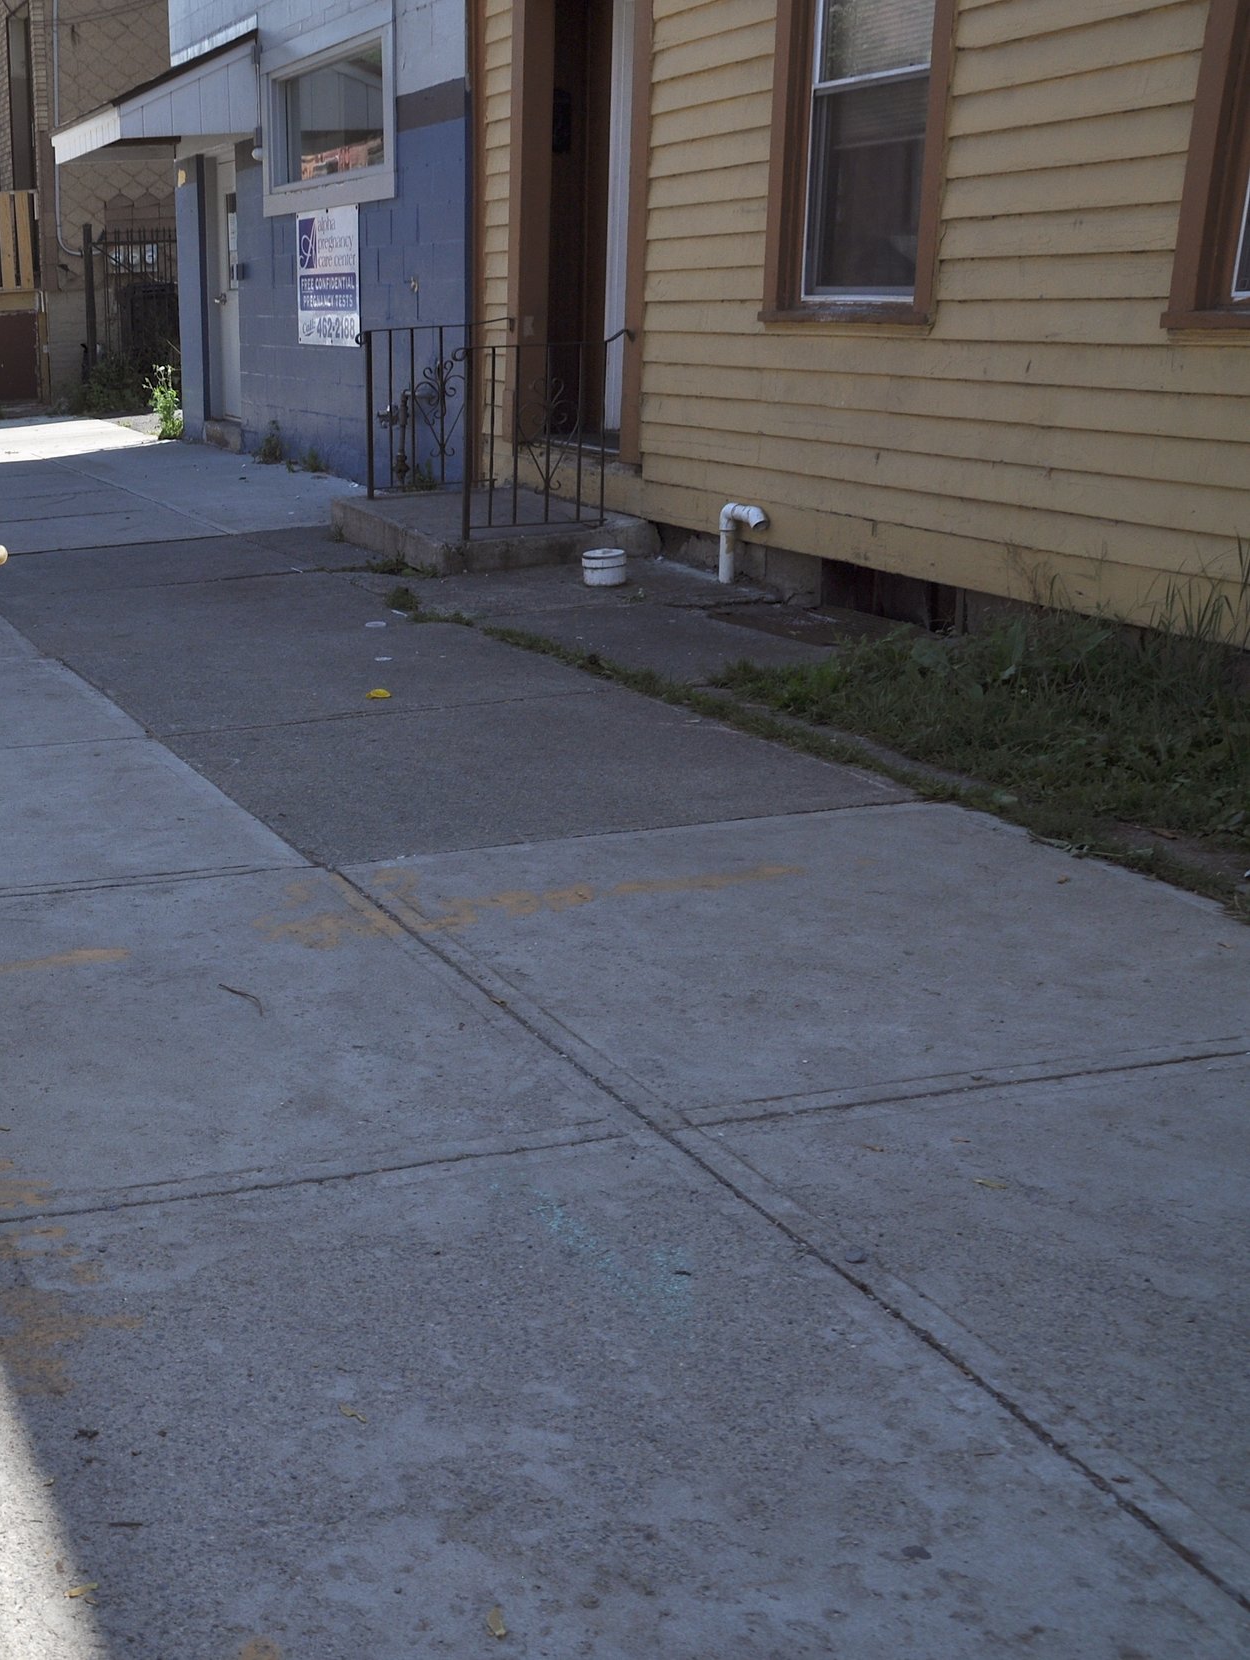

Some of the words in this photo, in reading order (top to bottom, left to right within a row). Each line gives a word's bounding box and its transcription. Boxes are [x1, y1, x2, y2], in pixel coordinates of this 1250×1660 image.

[318, 216, 335, 234] alpha
[318, 235, 353, 253] pregnancy
[318, 255, 332, 267] care
[334, 254, 356, 267] center
[301, 278, 314, 291] FREE
[315, 276, 355, 290] CONFIDENTIAL
[303, 295, 334, 308] PREGNANCY
[335, 294, 353, 307] TESTS
